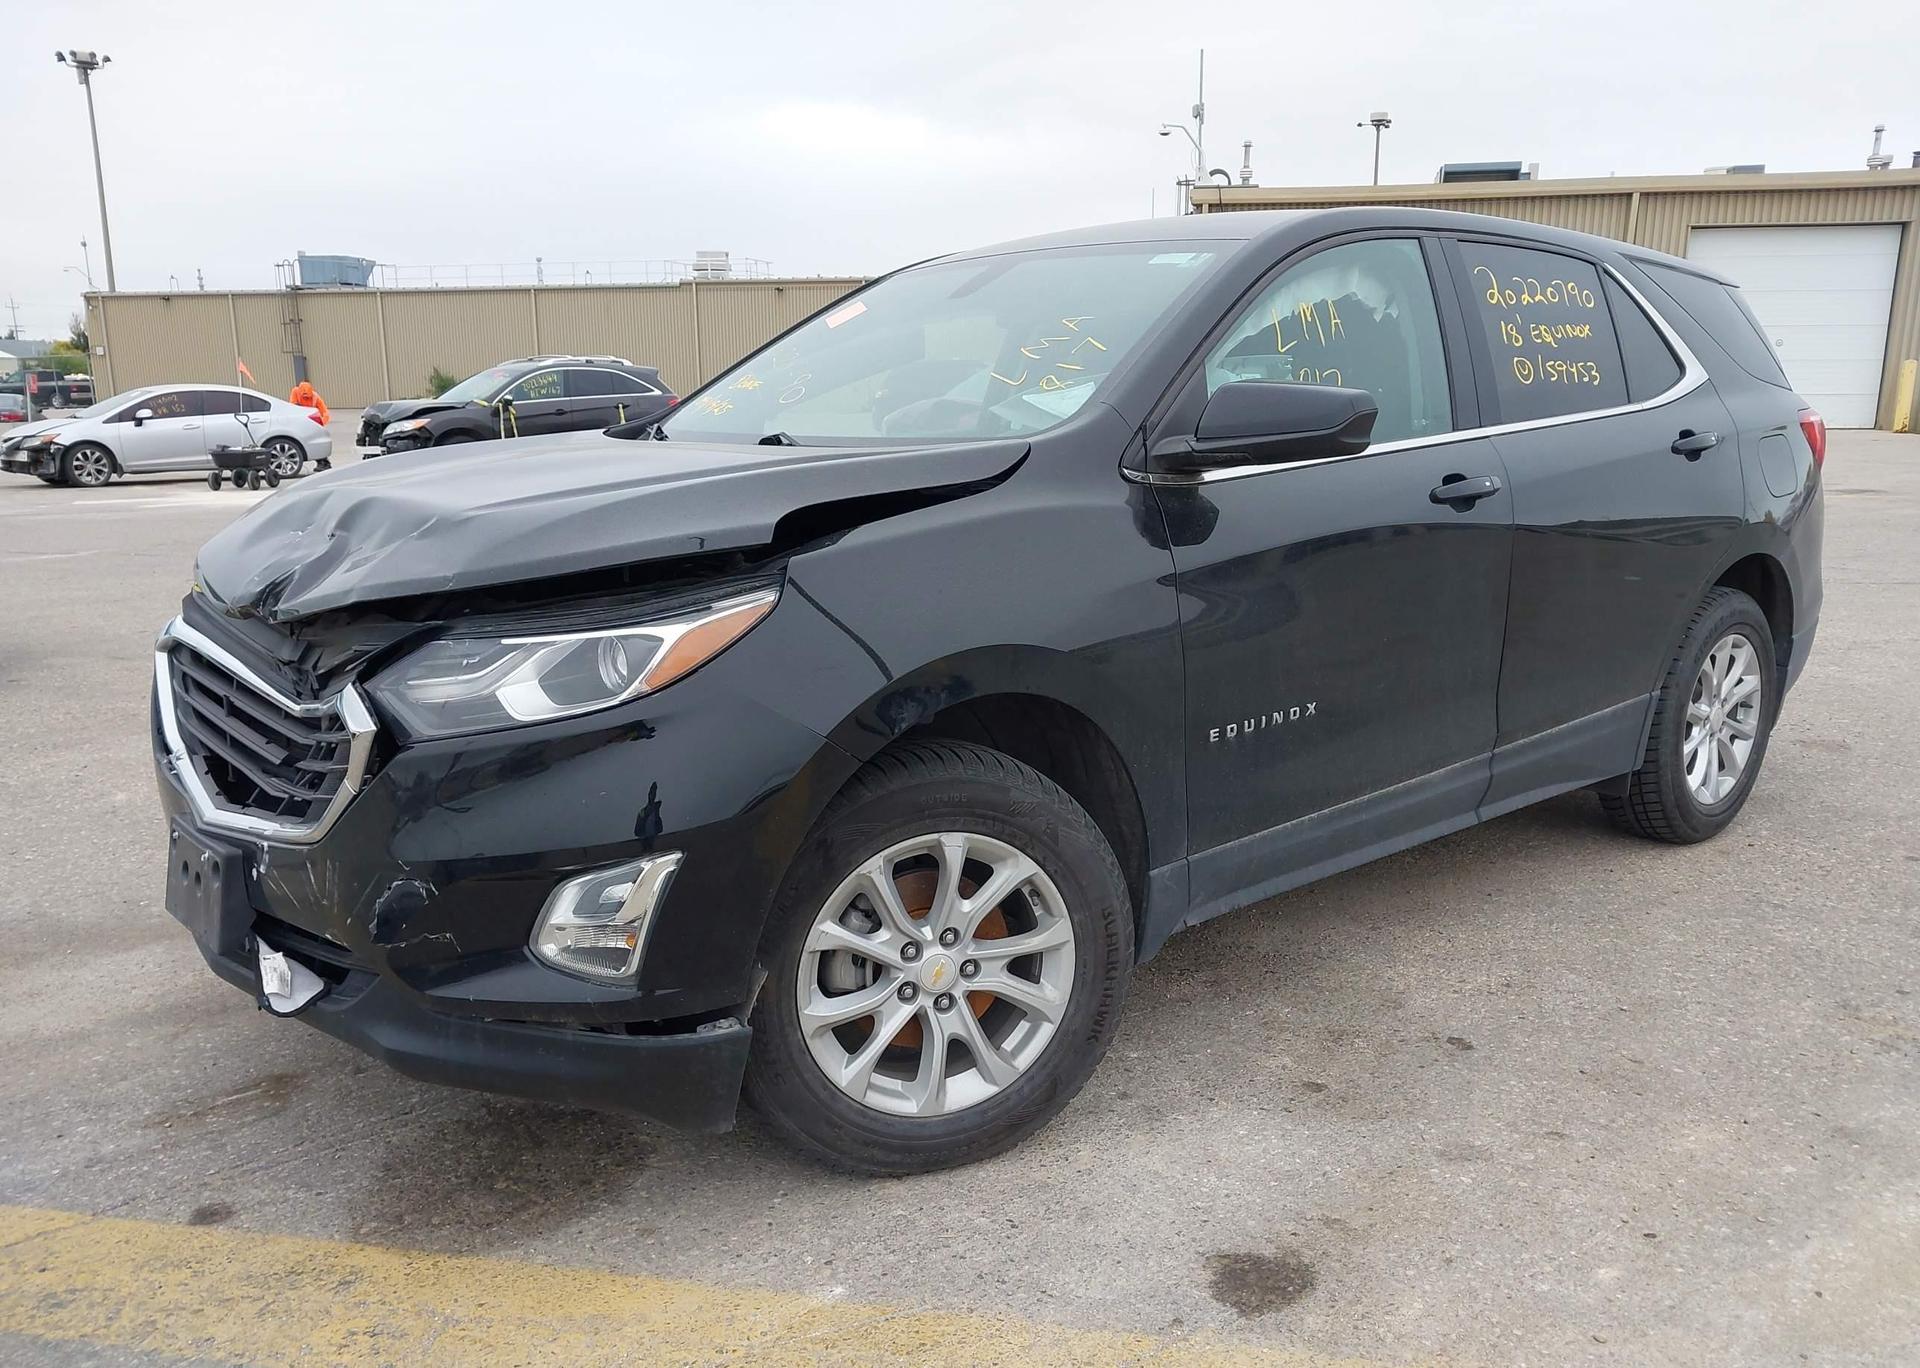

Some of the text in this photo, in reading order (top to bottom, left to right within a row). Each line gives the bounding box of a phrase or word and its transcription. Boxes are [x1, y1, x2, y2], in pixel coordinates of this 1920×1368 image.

[1474, 266, 1595, 309] 20220790
[1271, 298, 1346, 353] LMA
[1530, 323, 1592, 348] EQUINOX
[990, 316, 1096, 386] LMA
[1209, 701, 1318, 743] EQUINOX
